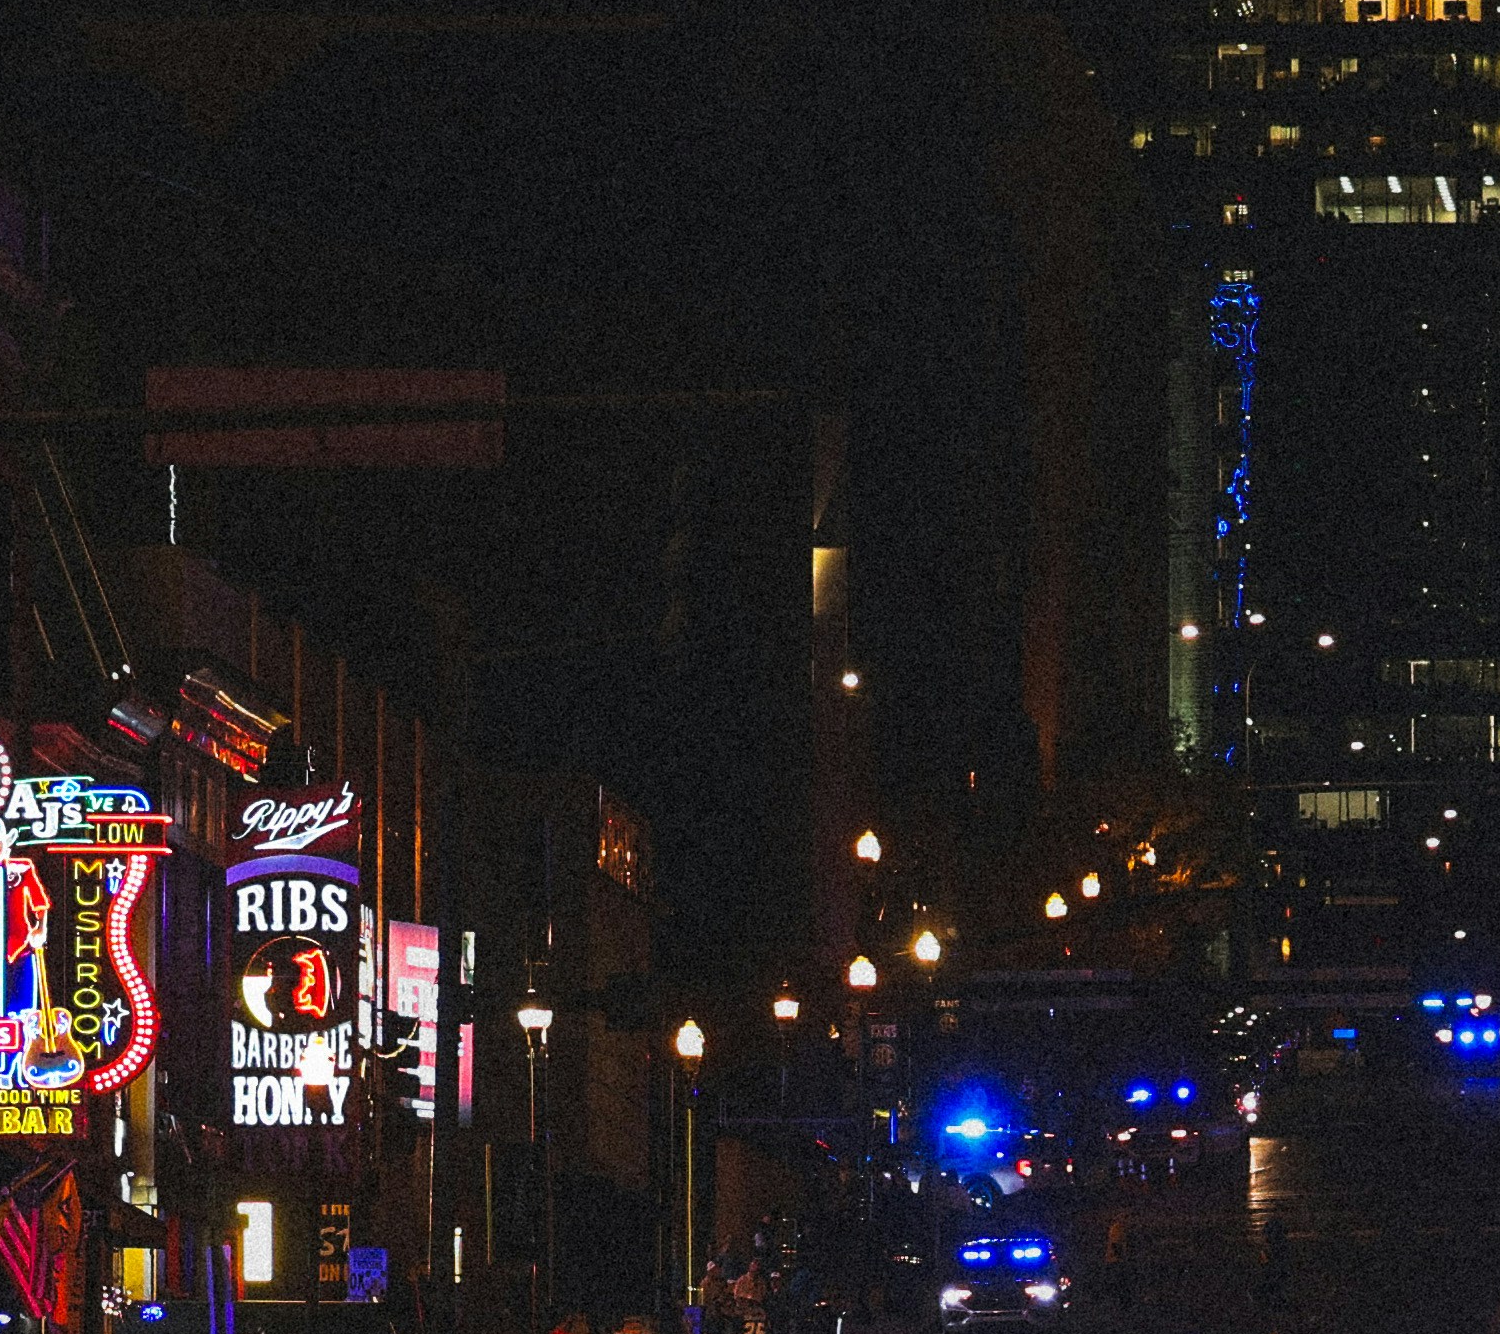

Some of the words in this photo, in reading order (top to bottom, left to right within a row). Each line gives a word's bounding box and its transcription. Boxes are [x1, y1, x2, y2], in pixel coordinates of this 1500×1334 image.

[231, 780, 354, 841] Rippy's
[236, 879, 349, 932] RIBS
[231, 1020, 353, 1070] BARBEUE
[36, 1089, 82, 1104] TIME
[233, 1075, 350, 1126] HONY
